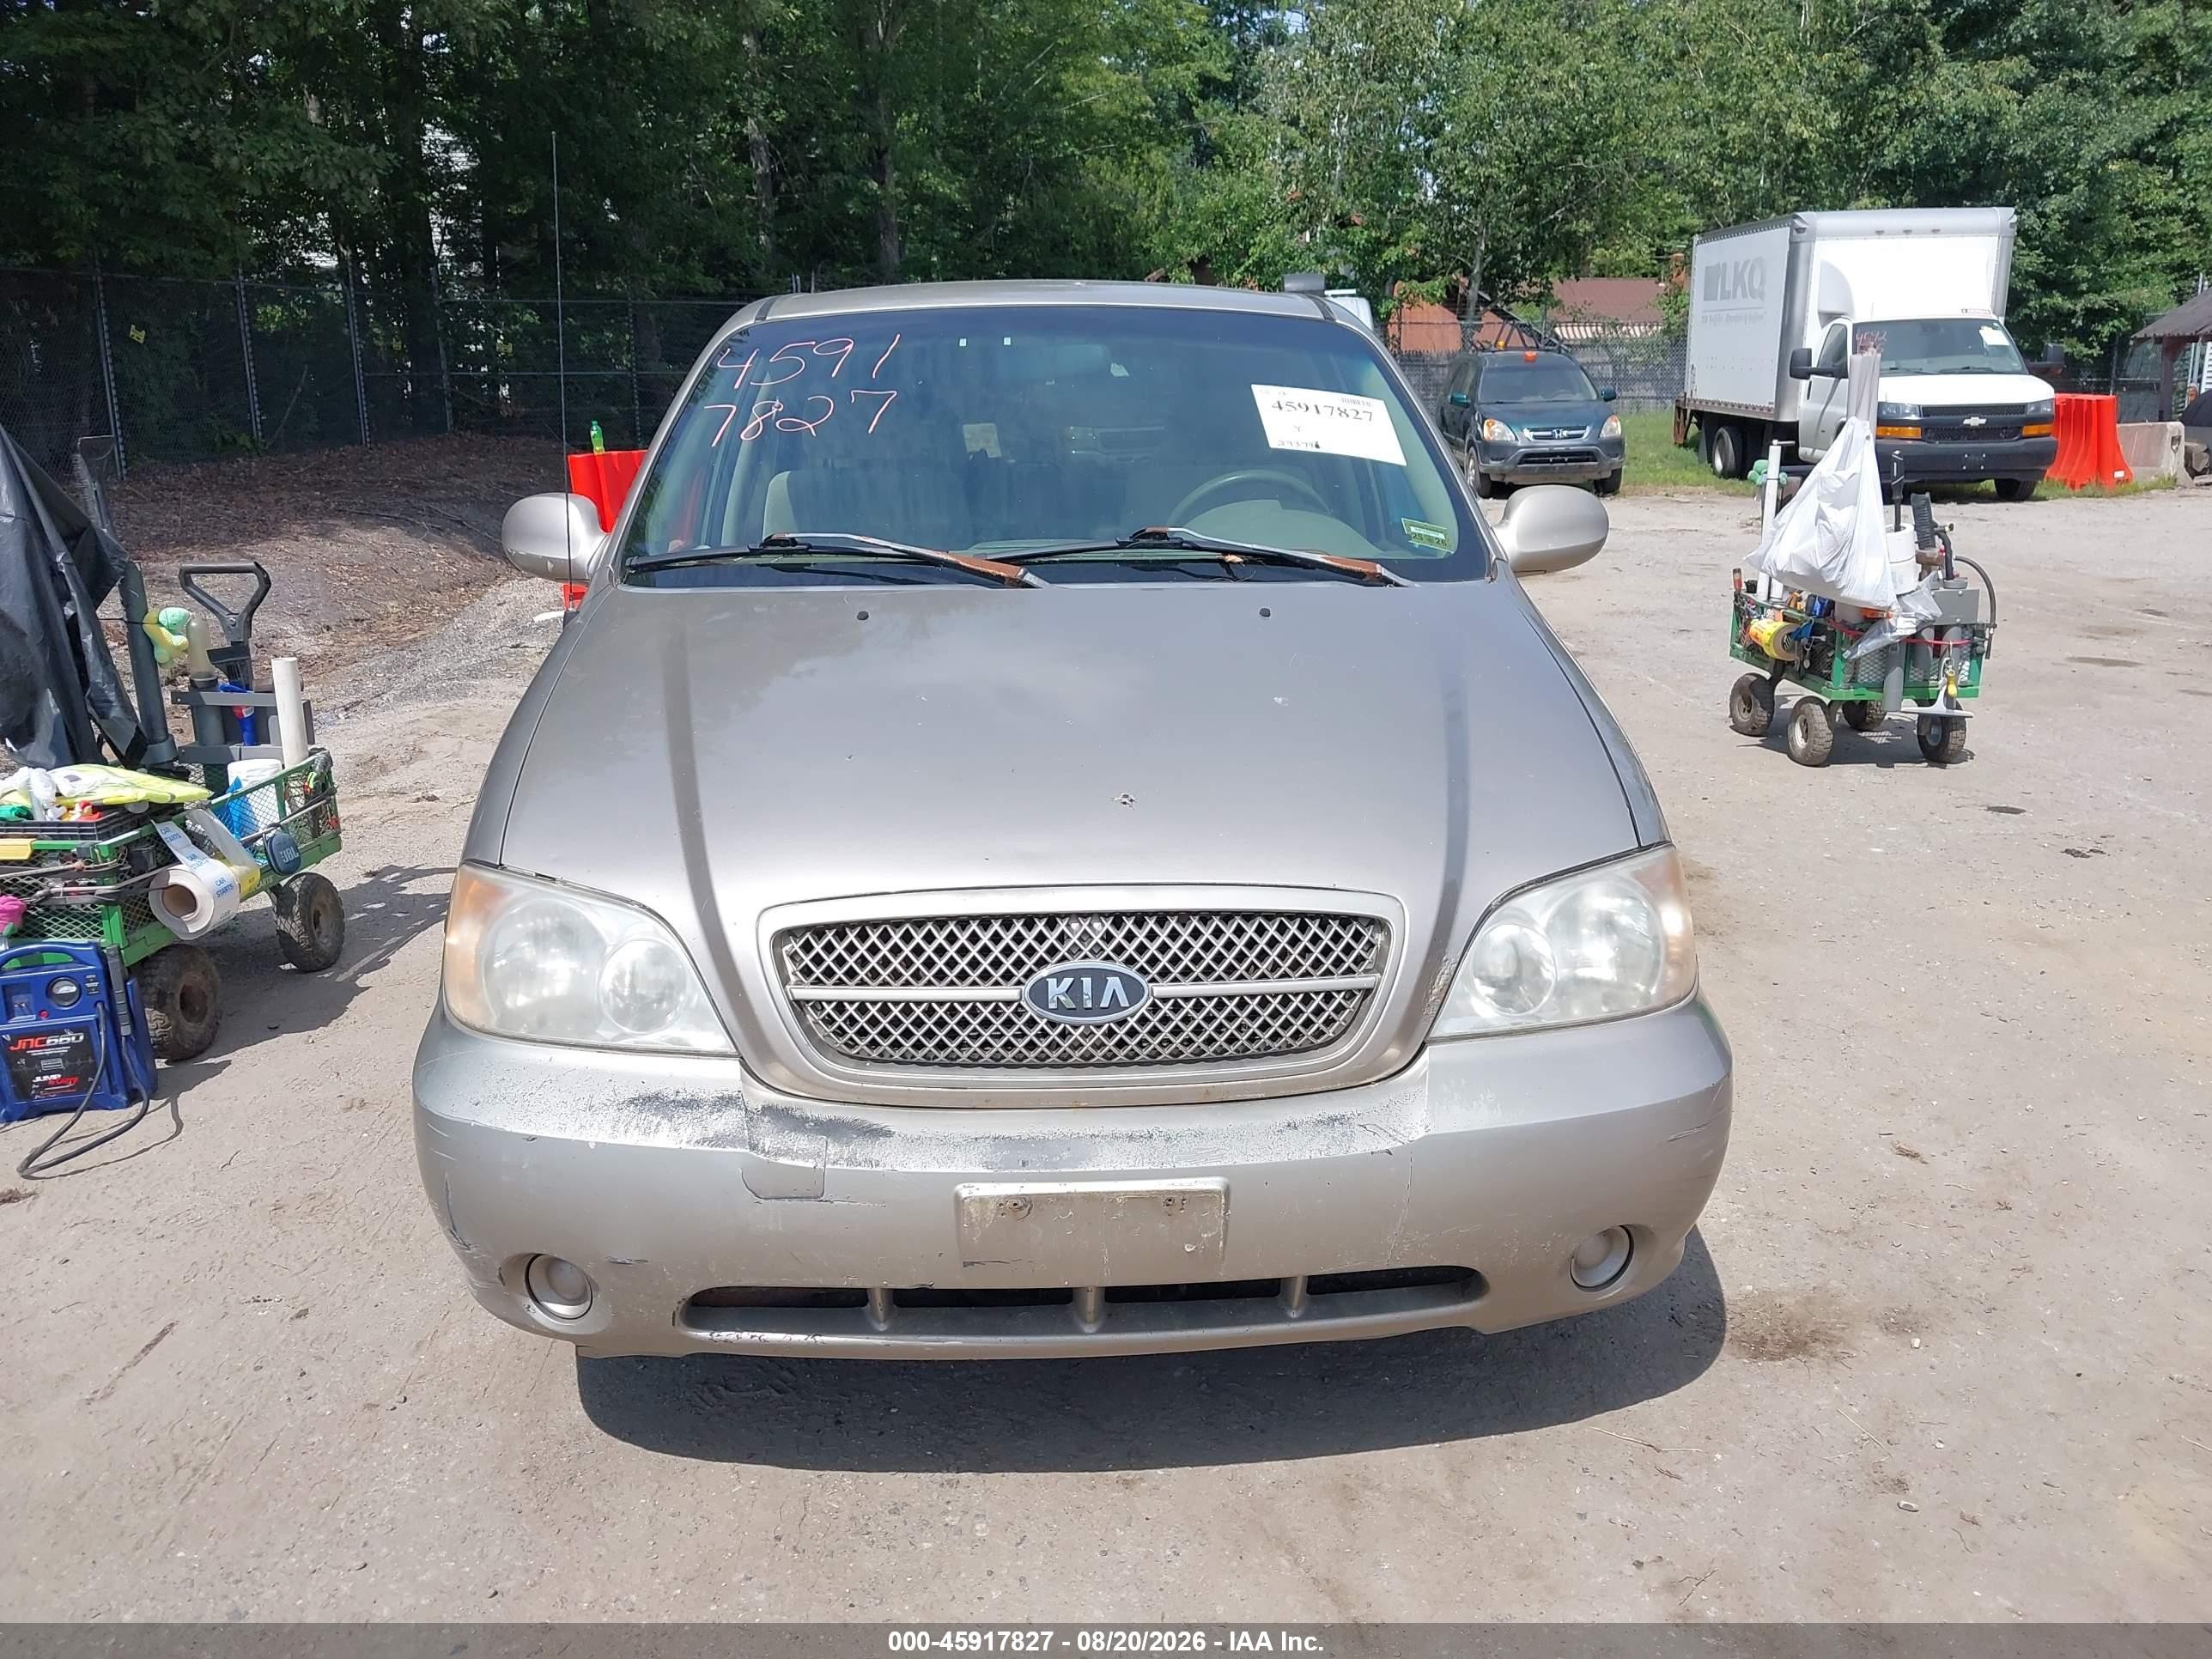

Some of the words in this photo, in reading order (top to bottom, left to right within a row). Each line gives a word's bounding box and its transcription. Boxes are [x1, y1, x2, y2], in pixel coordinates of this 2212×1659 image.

[1717, 257, 1766, 302] LKQ
[717, 332, 902, 390] 4591
[703, 389, 898, 447] 7827
[1271, 399, 1373, 422] 45917827
[279, 846, 300, 864] JBL
[215, 877, 228, 888] CAR
[216, 883, 235, 898] STARTS
[1046, 976, 1130, 1010] KIA
[32, 1073, 63, 1084] JUMP
